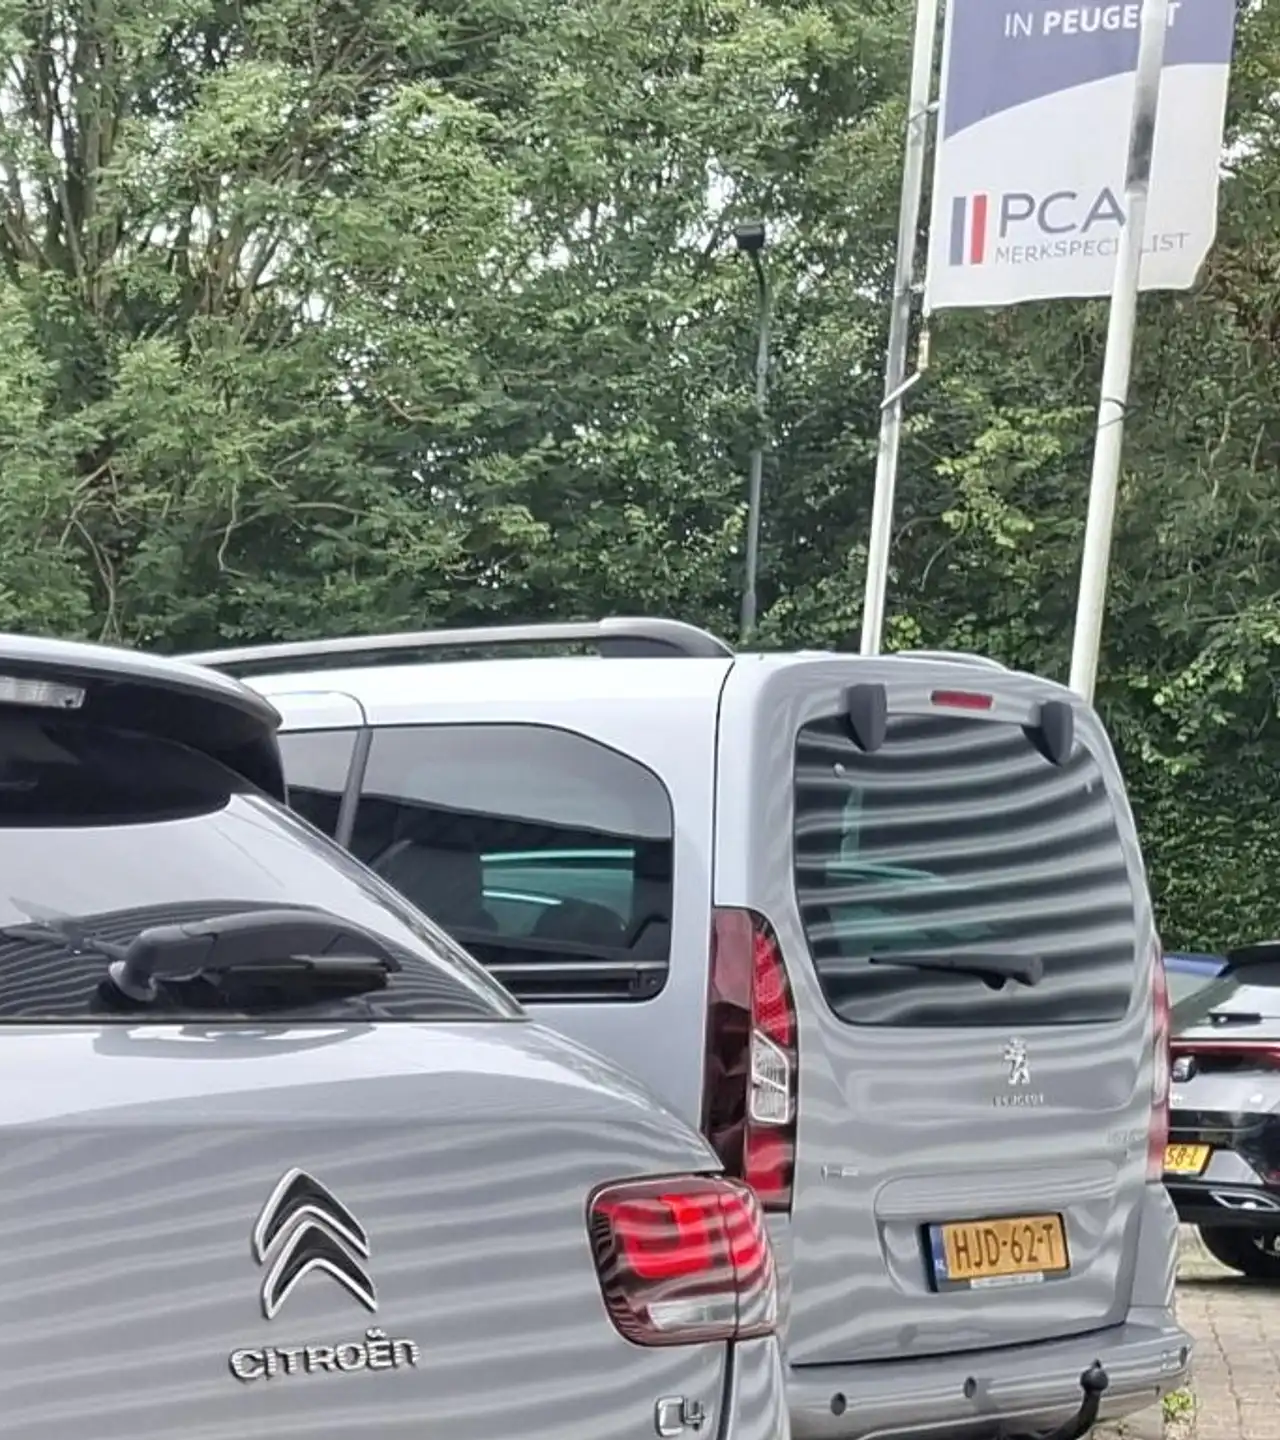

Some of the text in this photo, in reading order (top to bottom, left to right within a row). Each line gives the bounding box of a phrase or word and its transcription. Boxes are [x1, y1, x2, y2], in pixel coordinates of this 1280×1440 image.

[1004, 2, 1182, 38] IN PEUGET
[999, 186, 1127, 239] PCA
[953, 1223, 1054, 1271] HJD-62-T
[655, 1395, 706, 1437] C4
